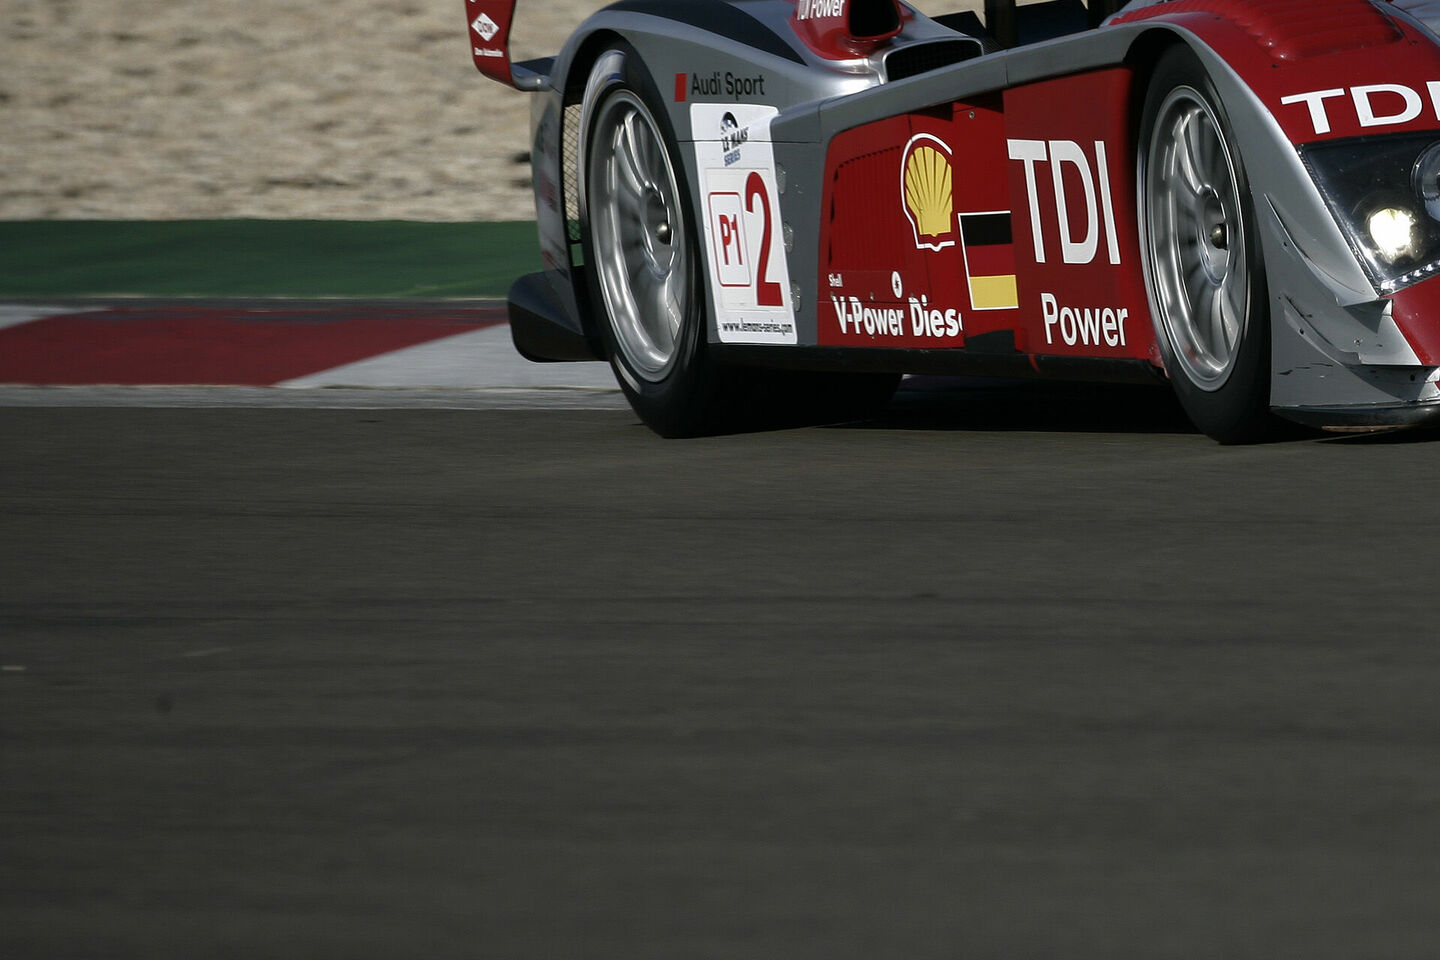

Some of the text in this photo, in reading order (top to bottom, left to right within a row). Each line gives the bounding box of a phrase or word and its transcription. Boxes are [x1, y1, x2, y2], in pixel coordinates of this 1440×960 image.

[691, 71, 765, 101] Audi Sport
[1007, 139, 1121, 265] TDI
[718, 213, 743, 265] P1
[746, 171, 784, 307] 2
[828, 272, 844, 287] Shell
[831, 295, 905, 336] V-Power
[1040, 292, 1129, 348] Power
